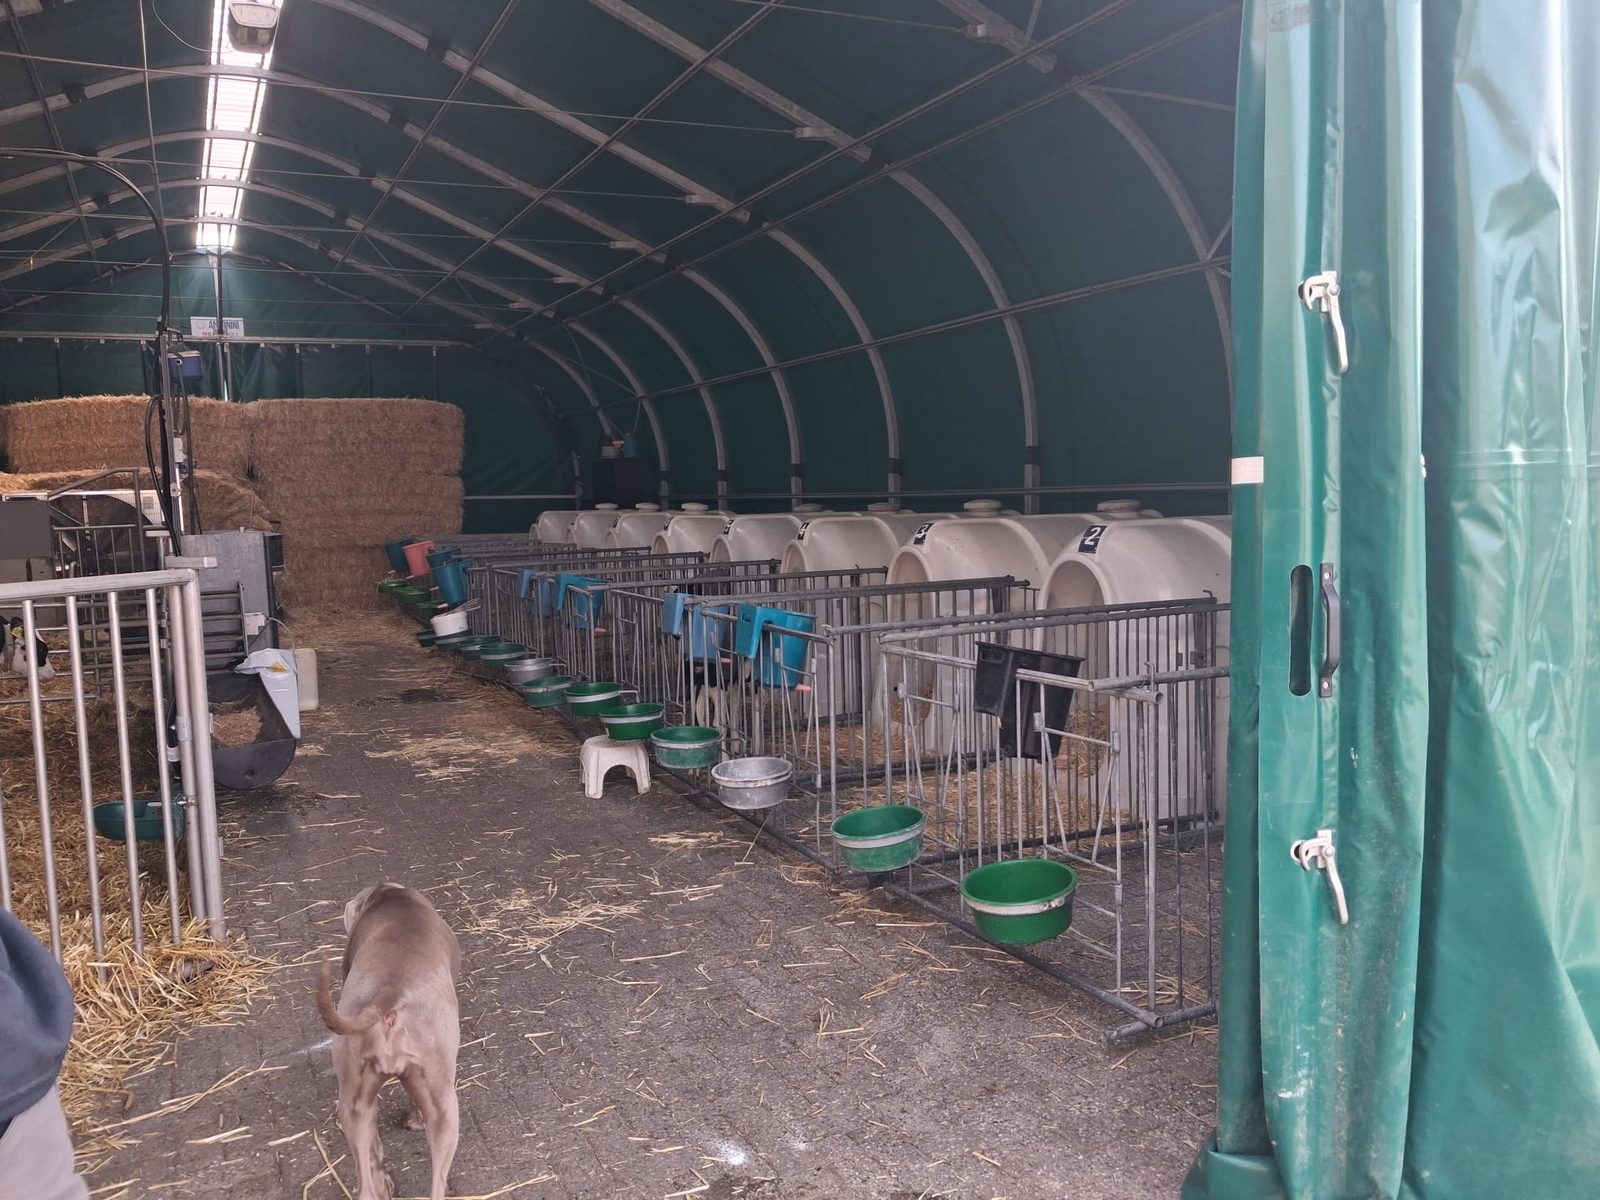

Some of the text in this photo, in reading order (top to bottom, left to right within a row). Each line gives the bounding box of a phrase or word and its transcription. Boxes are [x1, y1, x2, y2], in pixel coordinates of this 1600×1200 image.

[209, 320, 240, 330] ANNINI
[916, 523, 929, 537] 3
[1084, 526, 1101, 546] 2
